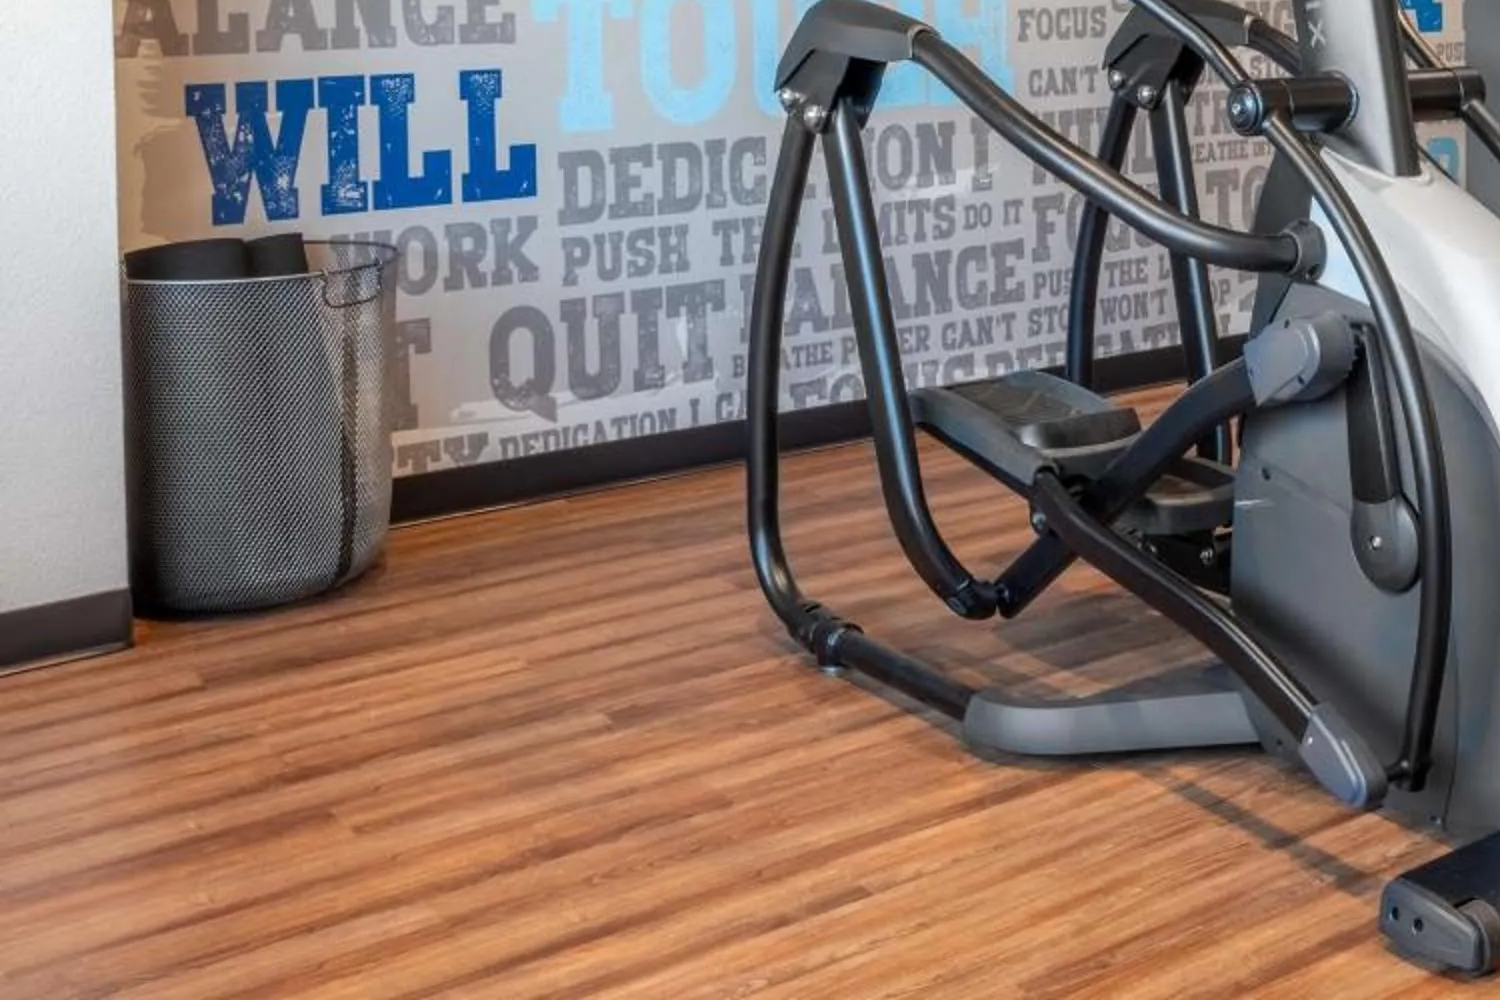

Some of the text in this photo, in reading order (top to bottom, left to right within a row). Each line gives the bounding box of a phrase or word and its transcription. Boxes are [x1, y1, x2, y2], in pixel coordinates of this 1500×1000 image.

[1017, 6, 1106, 43] FOCUS
[1028, 64, 1099, 98] CAN'T
[184, 68, 537, 227] WILL
[557, 121, 957, 226] DEDICON
[963, 199, 1024, 230] DO IT
[560, 216, 690, 288] PUSH
[1104, 256, 1149, 288] THE
[1099, 287, 1169, 326] WON'T
[488, 279, 725, 423] QUIT
[941, 311, 1017, 352] CAN'T
